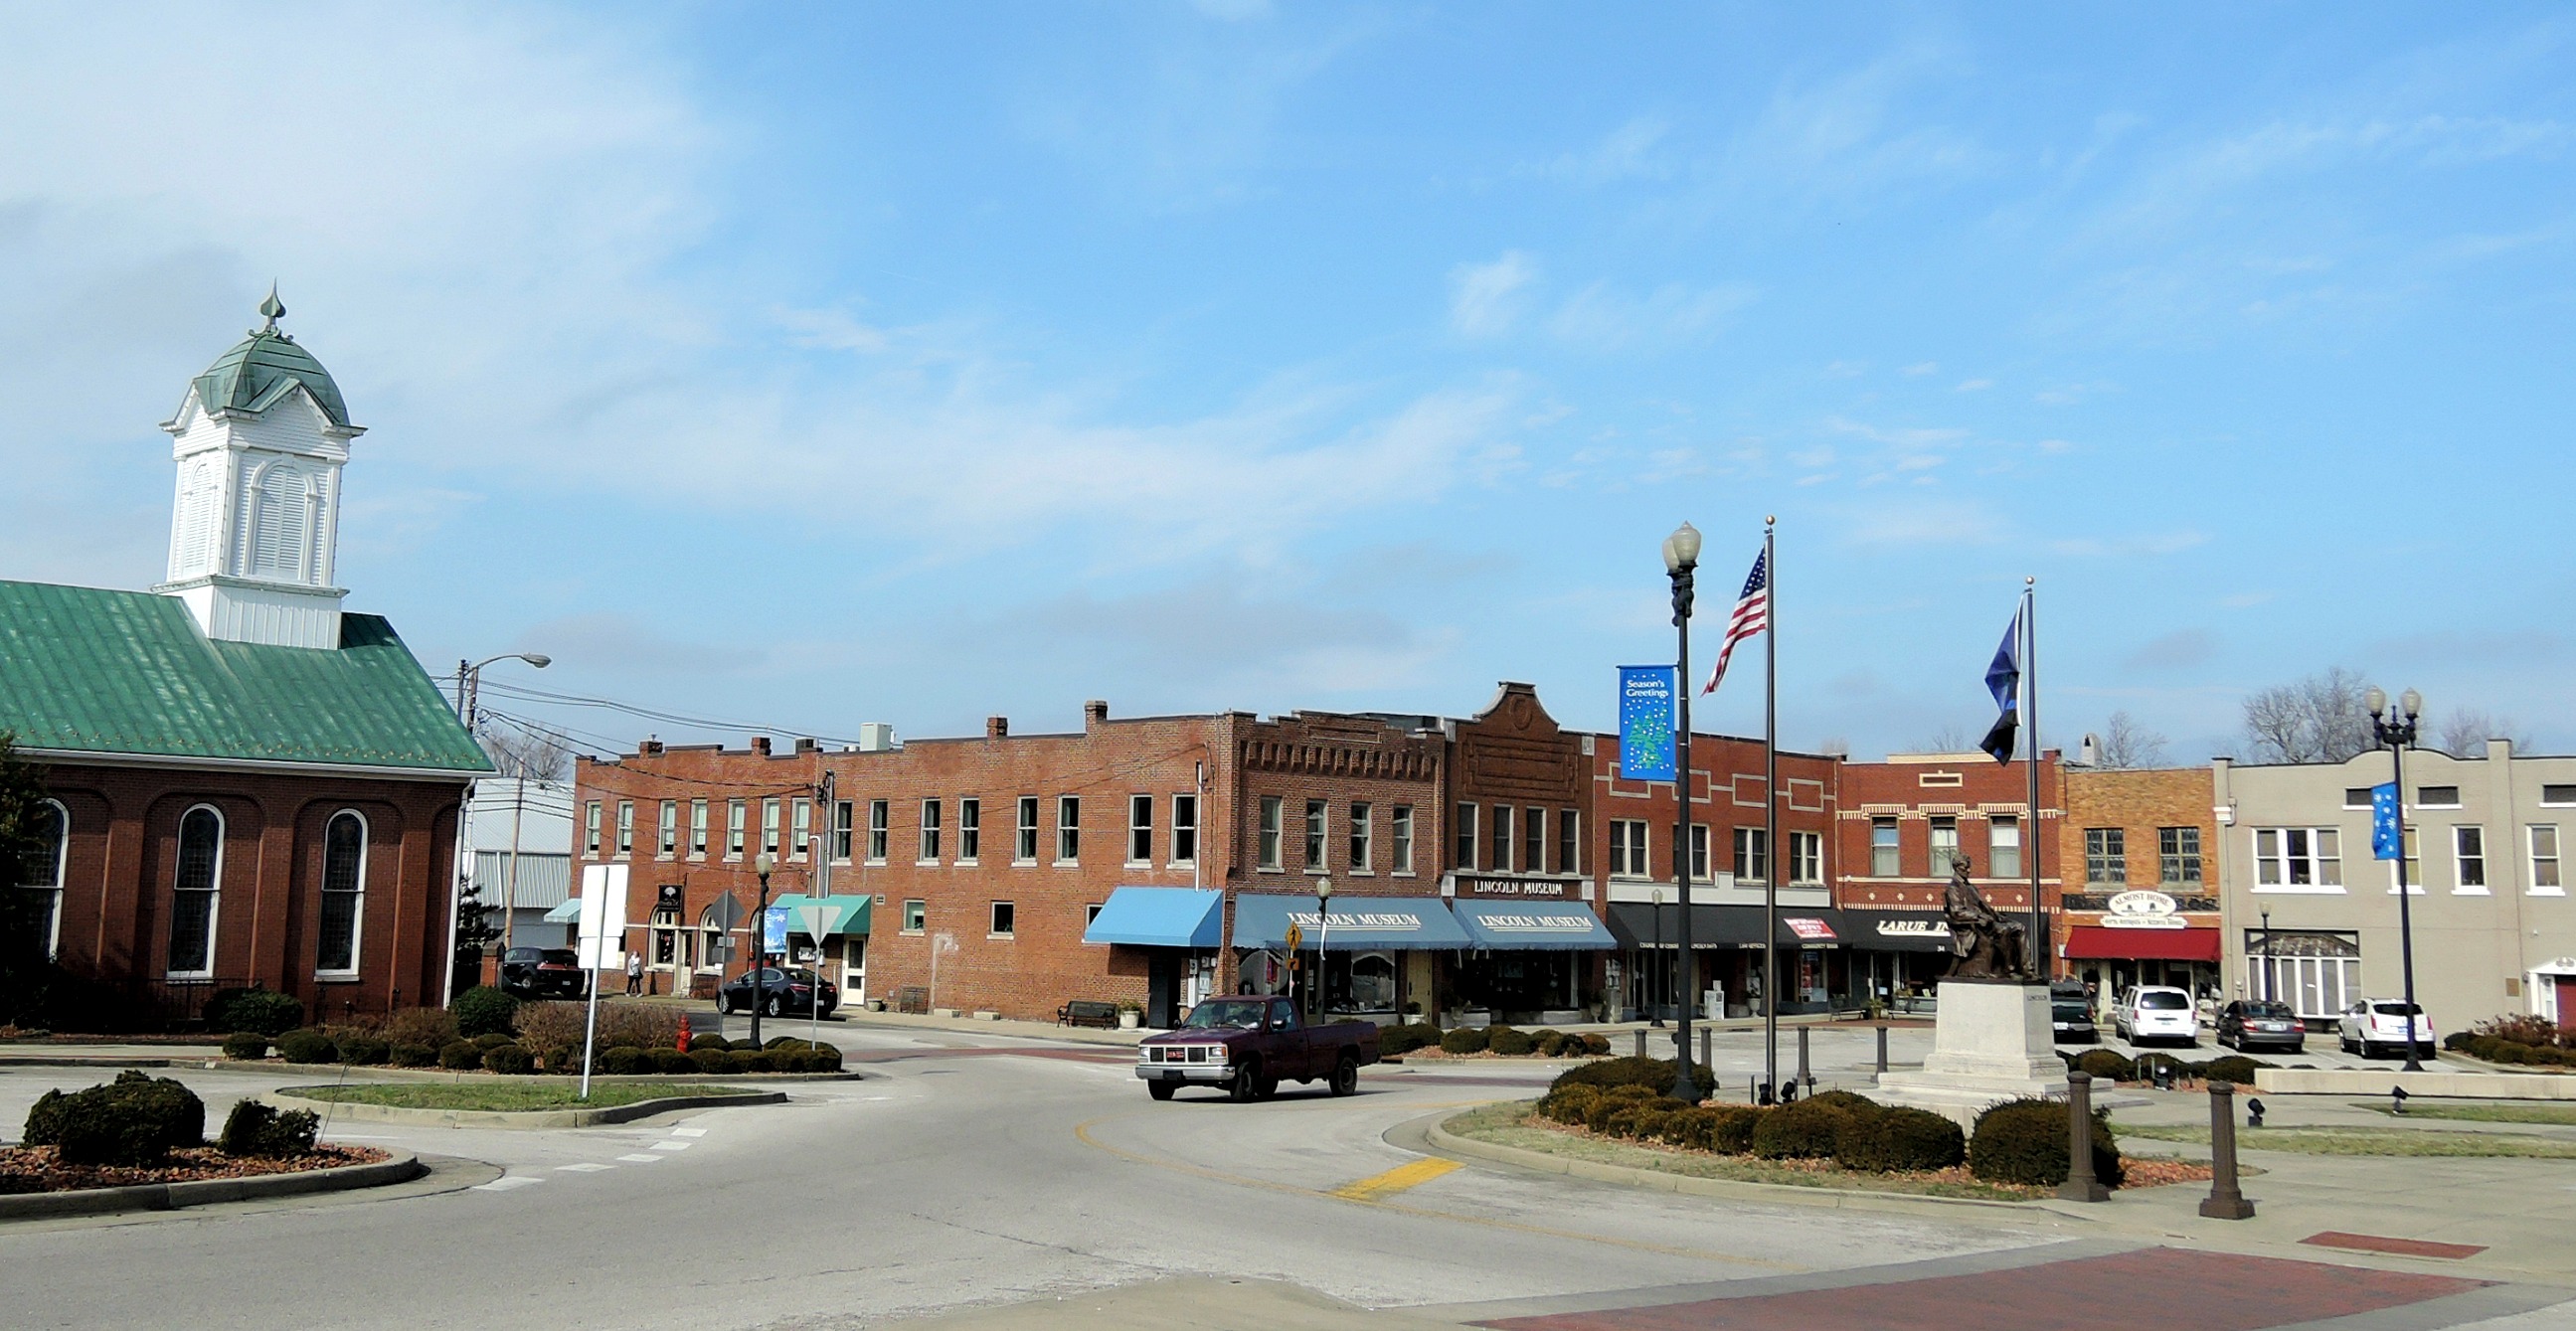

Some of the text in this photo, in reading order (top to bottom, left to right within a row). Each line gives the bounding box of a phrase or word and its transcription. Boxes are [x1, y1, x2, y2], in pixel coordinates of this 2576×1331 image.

[1626, 688, 1668, 698] Greetings
[1474, 880, 1563, 895] LINCOLN MUSEUM
[2115, 893, 2170, 907] ALMOST HOME
[1287, 913, 1422, 925] LINCOLN MUSEUM
[1477, 915, 1594, 927] LINCOLN MUSEUM
[1876, 920, 1929, 931] LARUE
